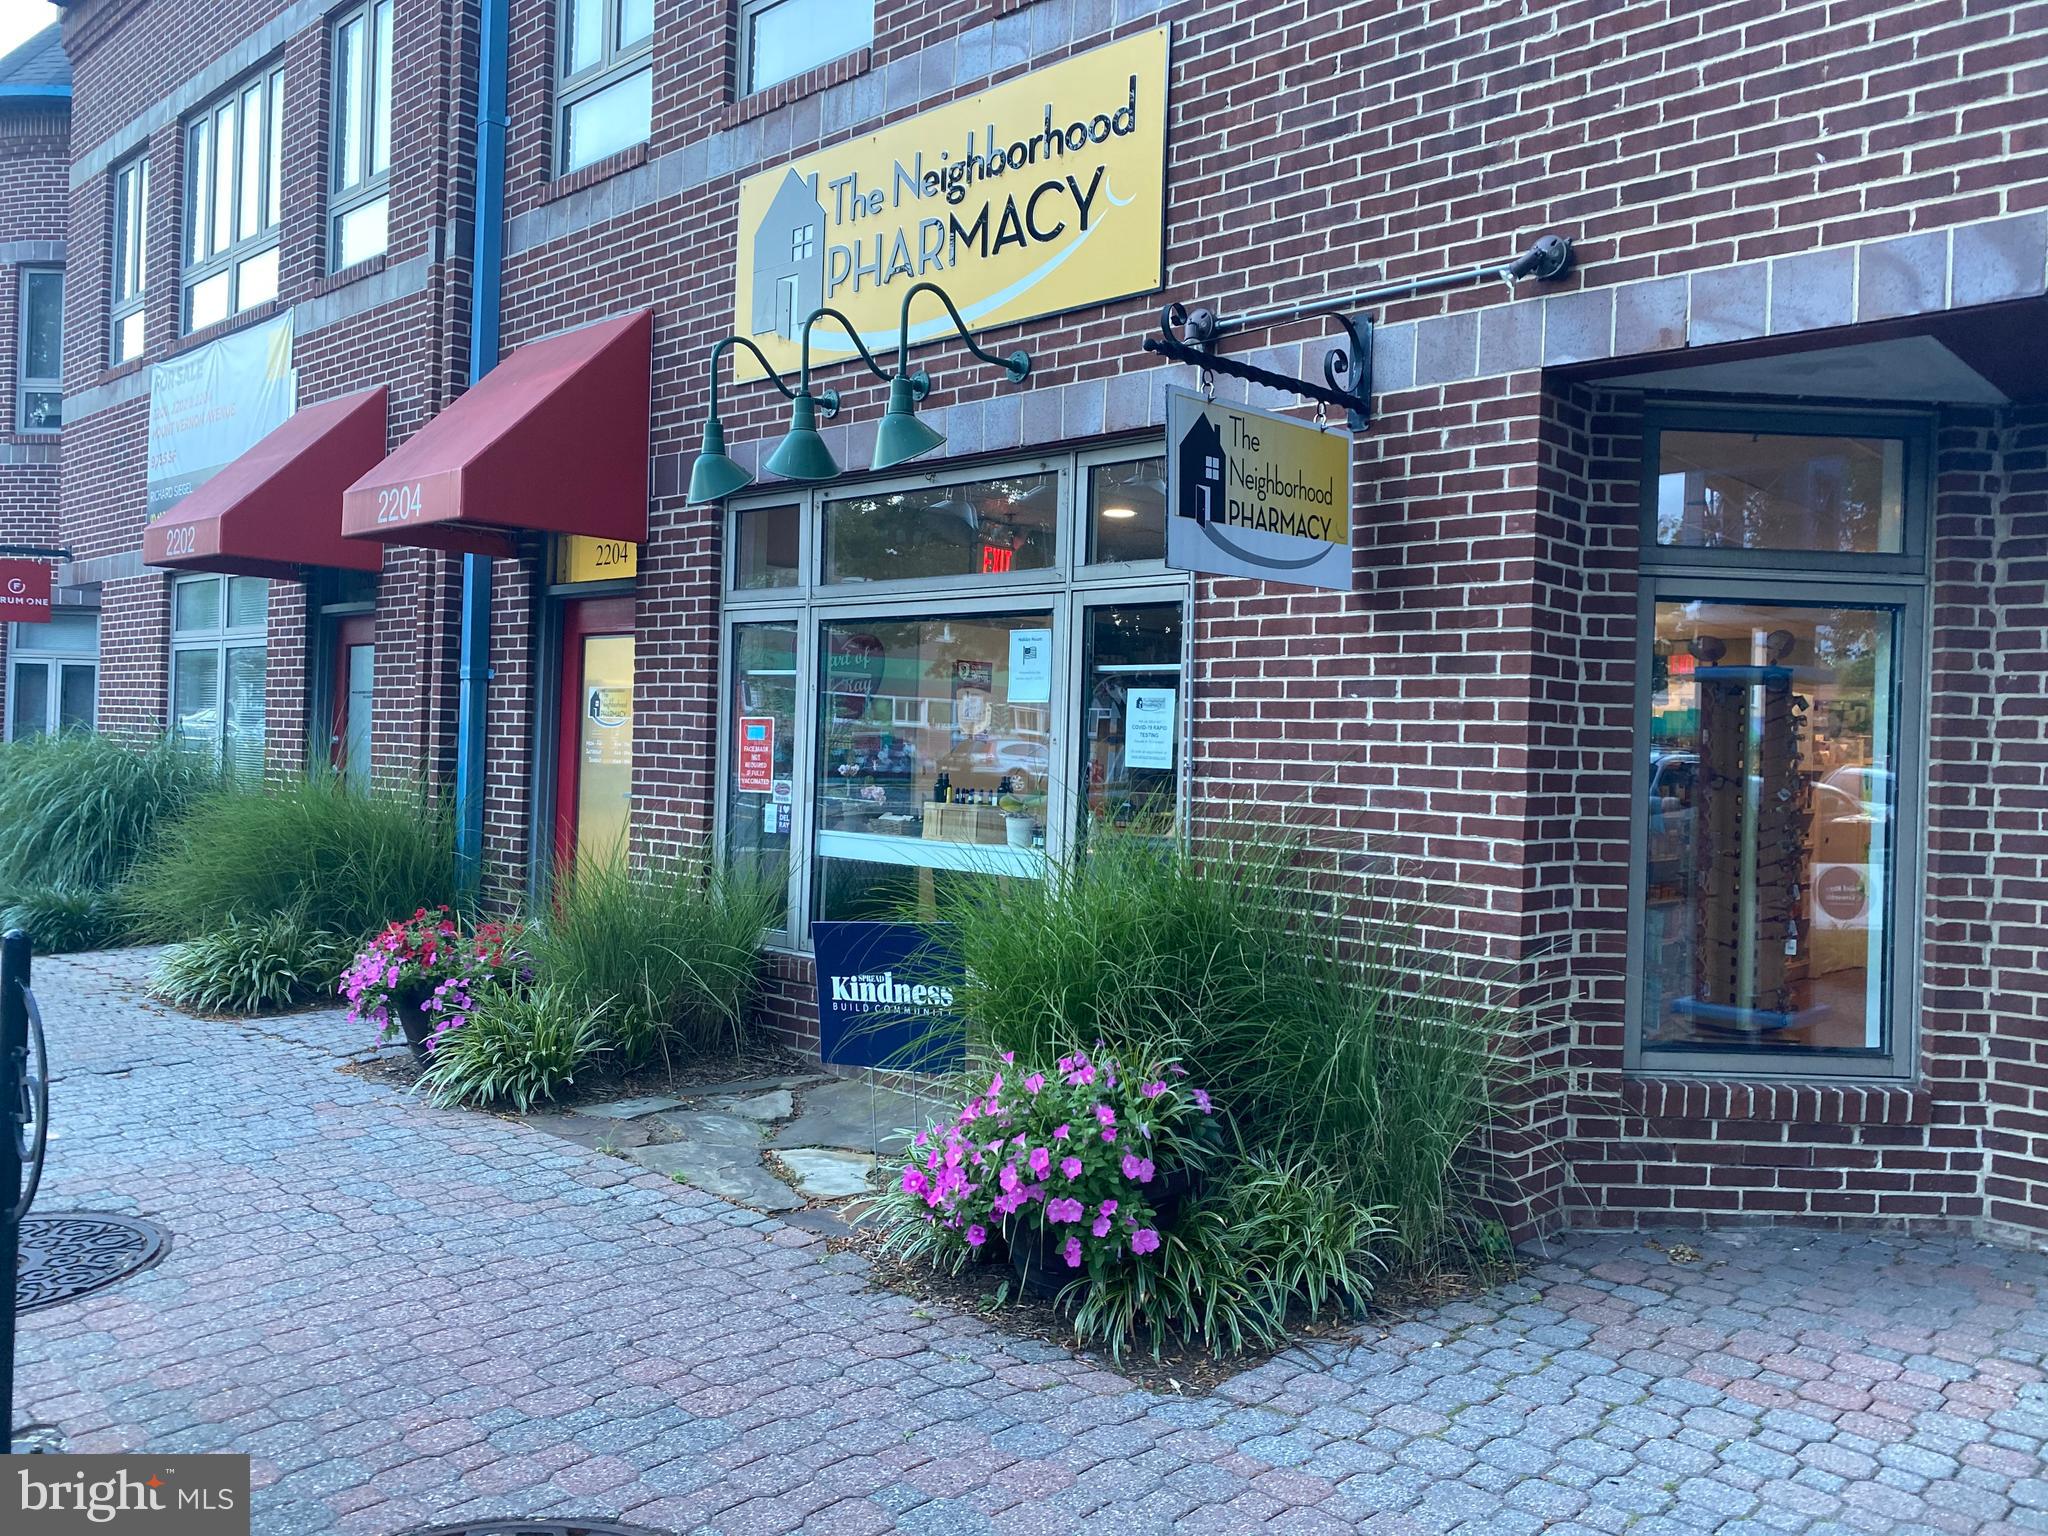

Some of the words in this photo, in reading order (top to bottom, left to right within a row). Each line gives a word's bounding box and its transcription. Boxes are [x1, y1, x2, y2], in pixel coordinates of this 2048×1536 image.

[828, 171, 884, 226] The
[893, 74, 1138, 207] Neighborhood
[827, 165, 1105, 299] PHARMACY
[154, 367, 175, 393] FOR
[175, 358, 205, 386] SALE
[176, 412, 206, 433] VERNON
[206, 402, 237, 425] AVENUE
[1229, 415, 1260, 452] The
[150, 486, 174, 503] RICHARD
[173, 481, 194, 497] SIEGEL
[1229, 456, 1333, 506] Neighborhood
[377, 482, 422, 524] 2204
[1229, 500, 1332, 541] PHARMACY
[166, 526, 196, 556] 2202
[595, 542, 629, 567] 2204
[983, 546, 1013, 574] EXIT
[0, 596, 24, 605] RUM
[26, 597, 49, 606] ONE
[779, 814, 790, 822] DEL
[779, 821, 790, 829] RAY
[830, 972, 954, 1006] Kindness
[857, 974, 885, 983] SPREAD
[832, 1002, 869, 1013] BUILD
